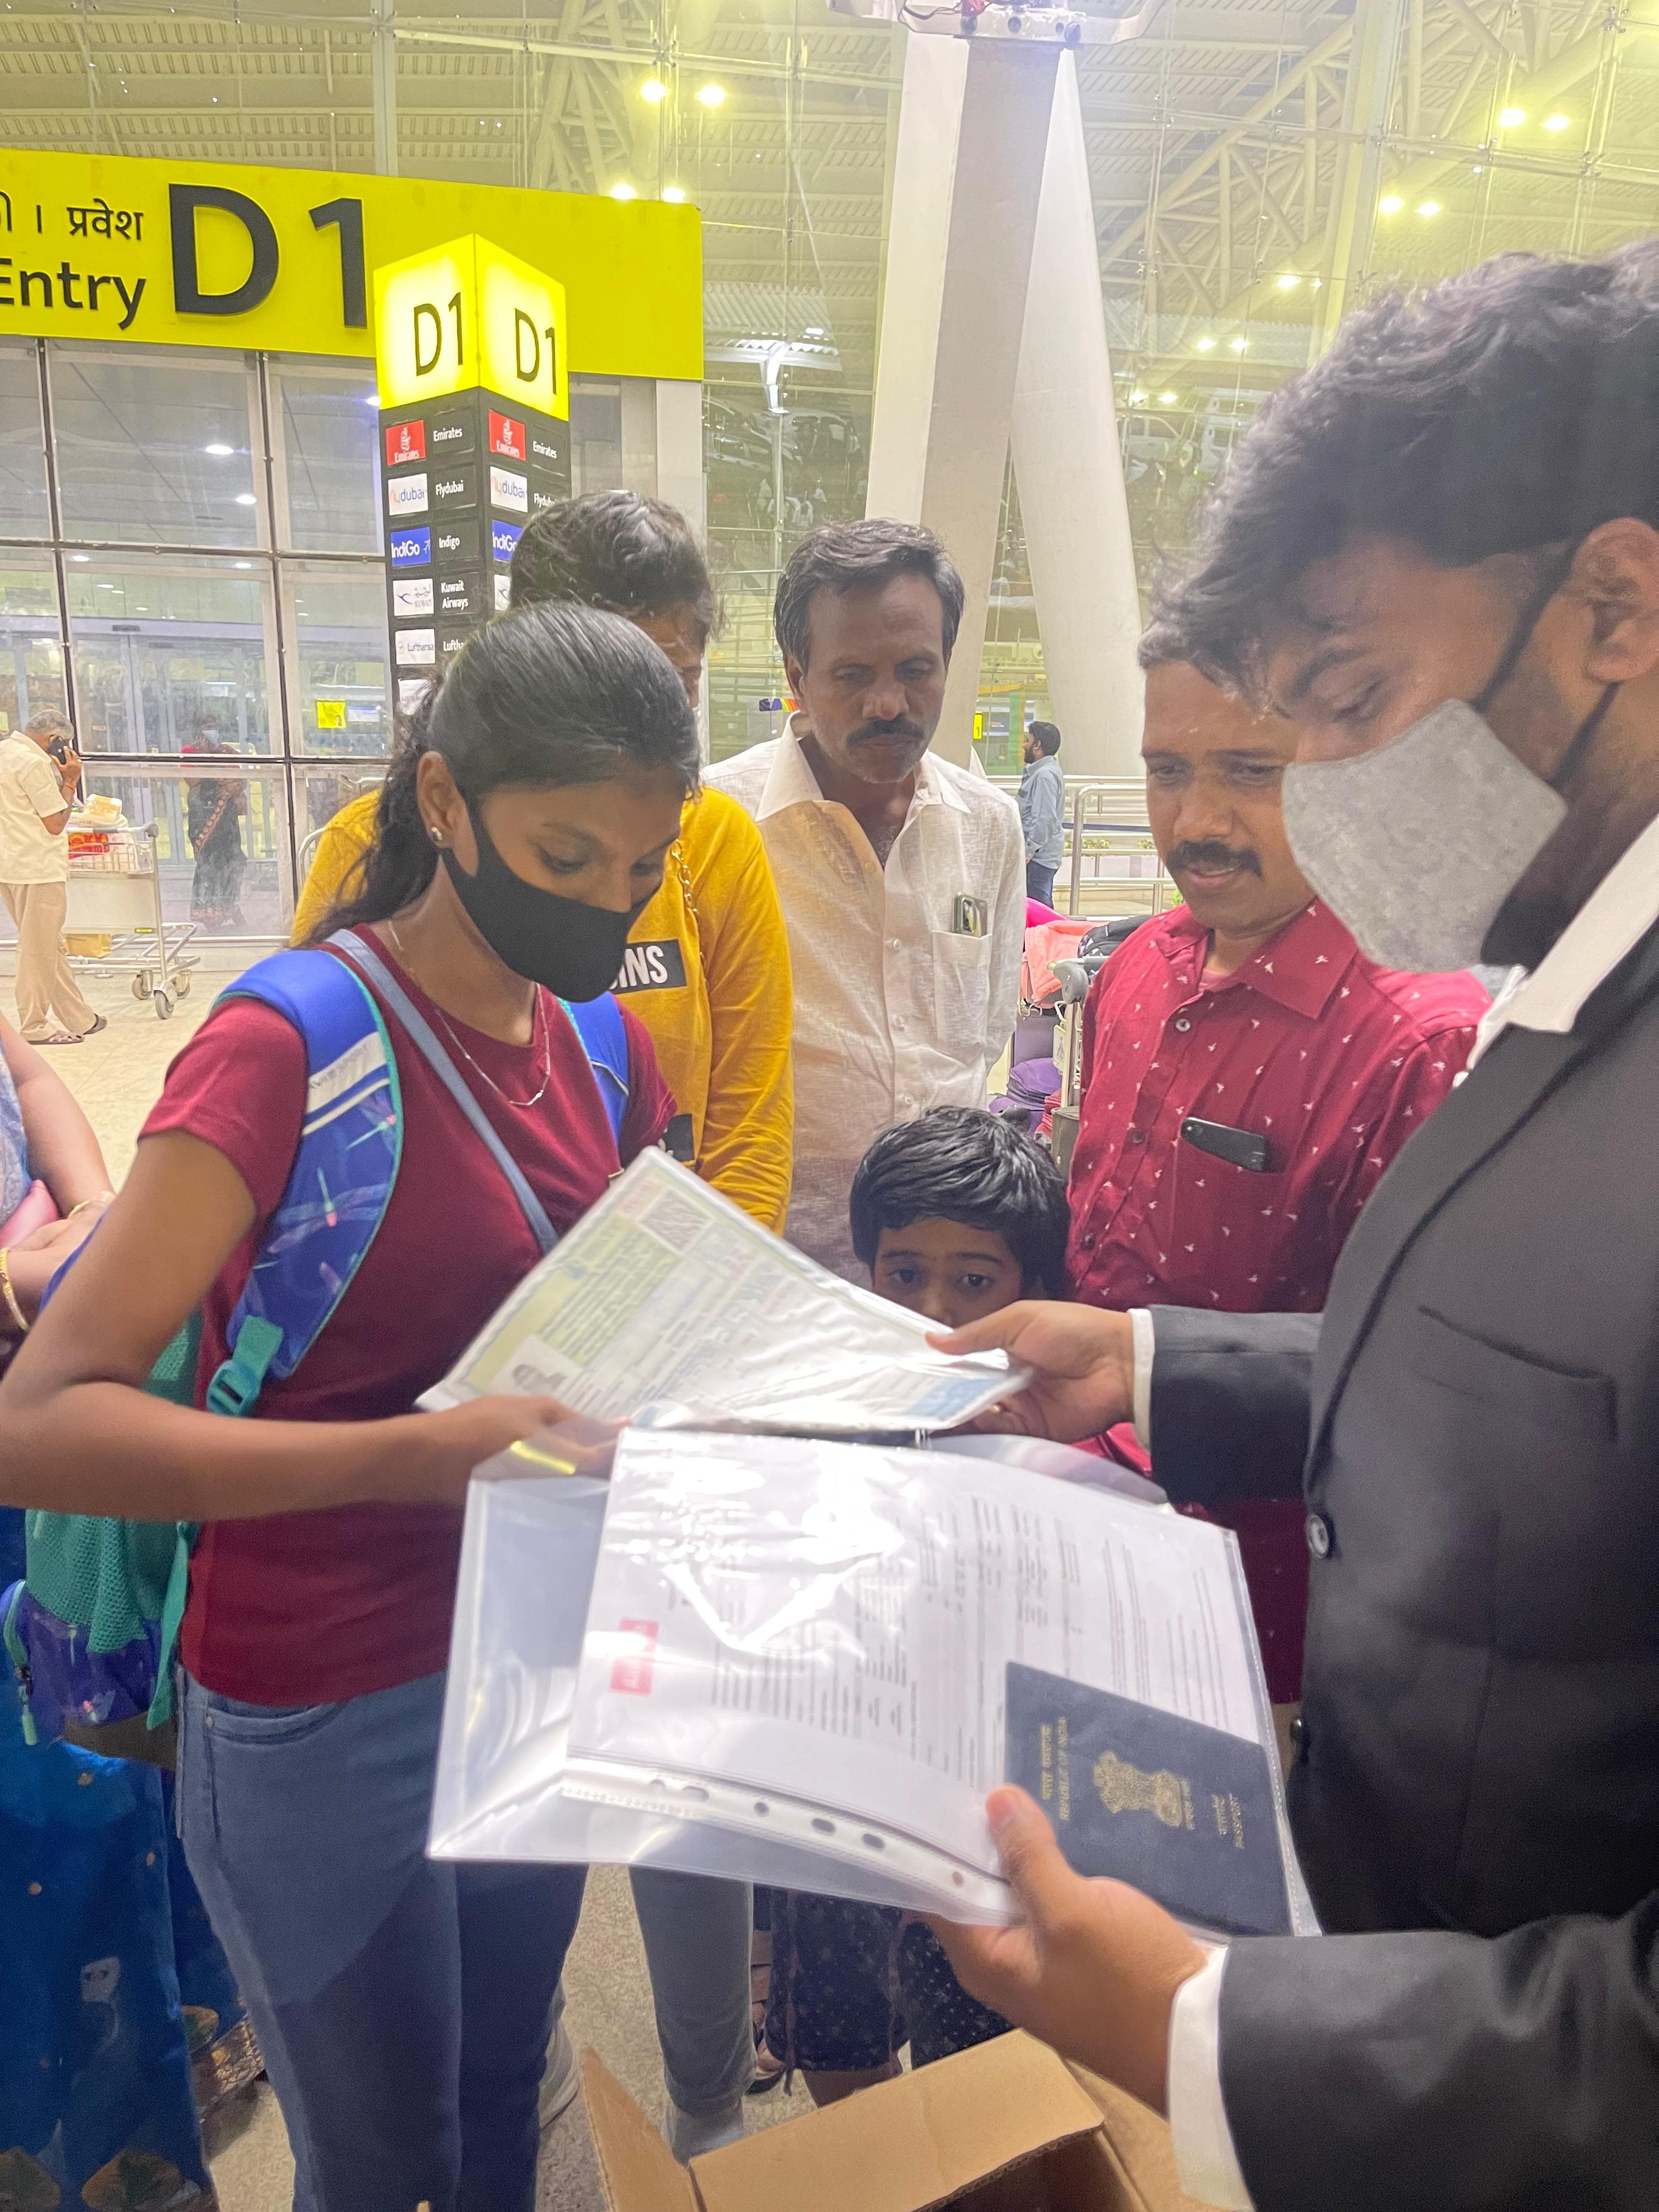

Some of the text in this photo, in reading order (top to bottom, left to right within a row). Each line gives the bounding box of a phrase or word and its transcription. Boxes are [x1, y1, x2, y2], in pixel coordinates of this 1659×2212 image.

[66, 198, 144, 240] प्रवेश
[169, 184, 368, 329] D1
[0, 258, 146, 330] Entry
[414, 291, 463, 376] D1
[515, 308, 557, 395] D1
[433, 427, 462, 442] Emirates
[533, 441, 557, 459] Emirates
[436, 479, 464, 498] Flydubai
[534, 493, 555, 508] Flydub
[391, 540, 420, 558] IndiGo
[439, 535, 460, 550] Indigo
[441, 580, 465, 593] Kuwait
[442, 597, 469, 611] Airways
[408, 642, 434, 652] Lufthansa
[443, 639, 464, 651] Lufth
